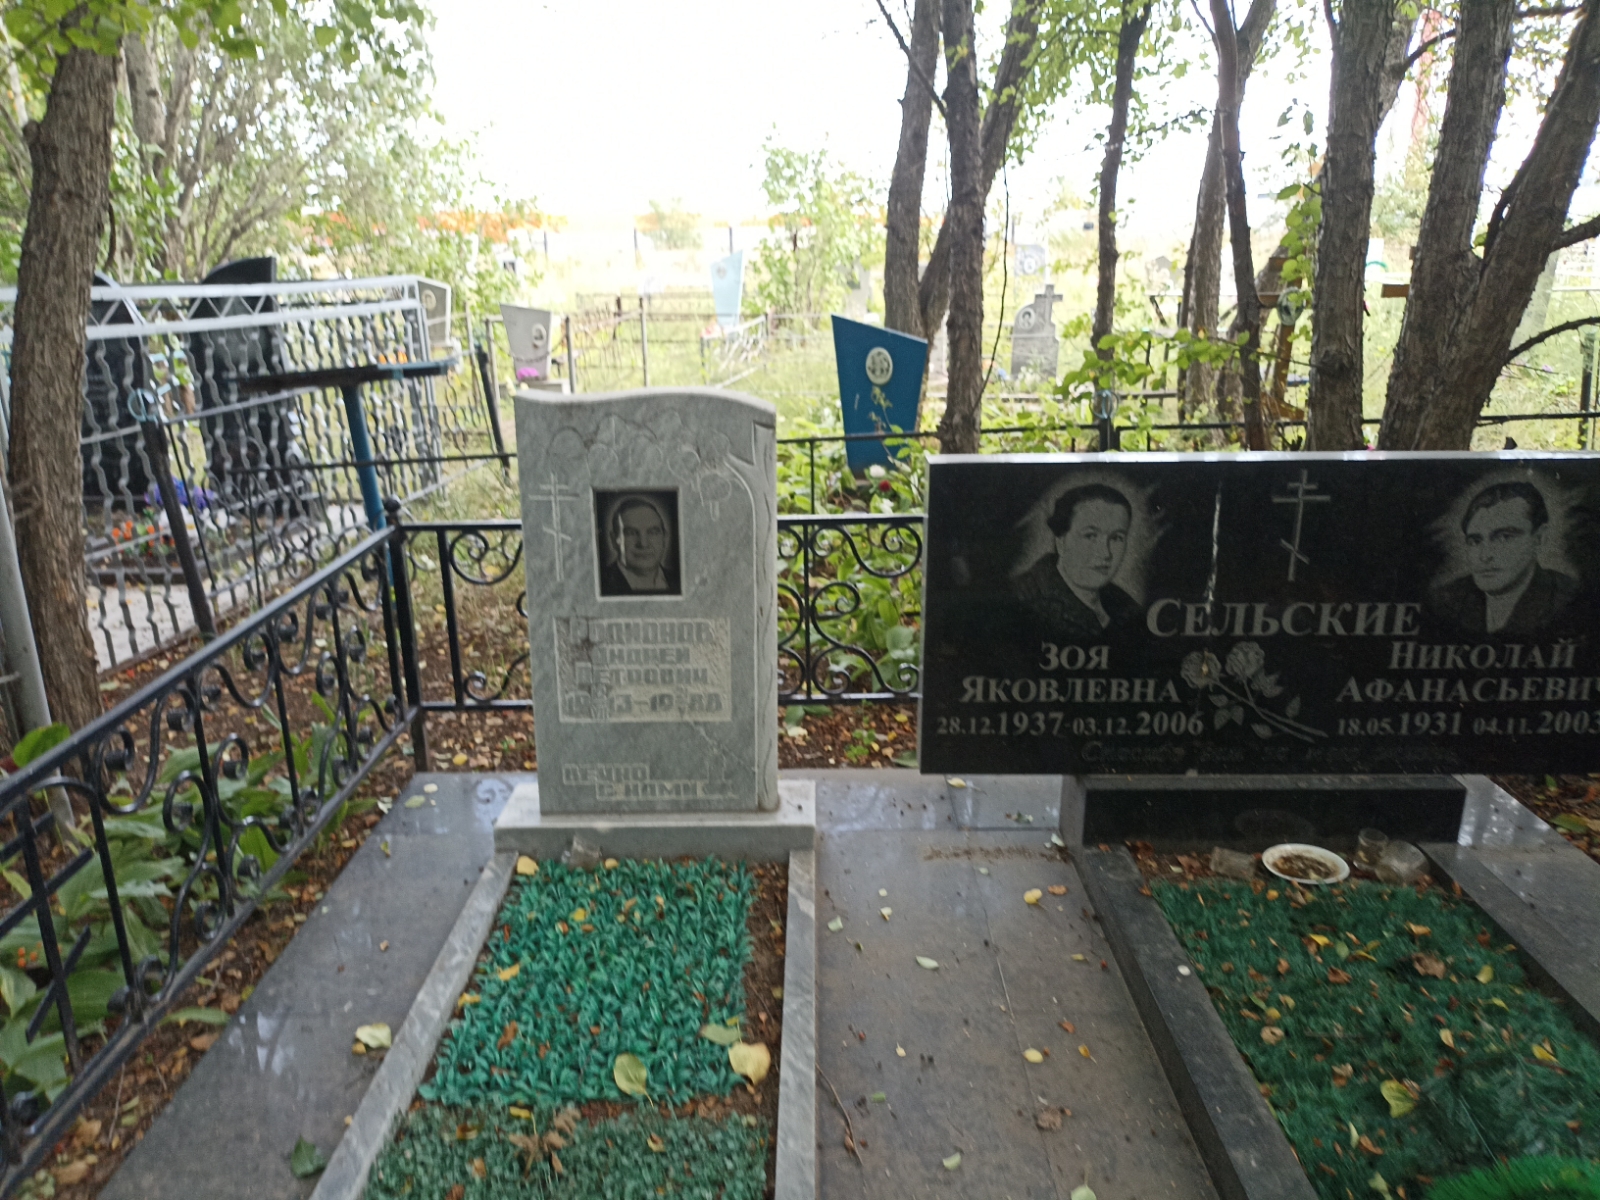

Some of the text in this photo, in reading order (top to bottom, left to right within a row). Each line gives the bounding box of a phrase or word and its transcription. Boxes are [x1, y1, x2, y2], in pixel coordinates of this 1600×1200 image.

[1146, 599, 1421, 637] СЕЛЬСКИЕ
[1039, 641, 1110, 671] ЗОЯ
[1388, 638, 1577, 670] НИКОЛАЙ
[959, 675, 1181, 704] ЯКОВЛЕВНА
[1336, 676, 1600, 703] АФАНАСЬЕВИ
